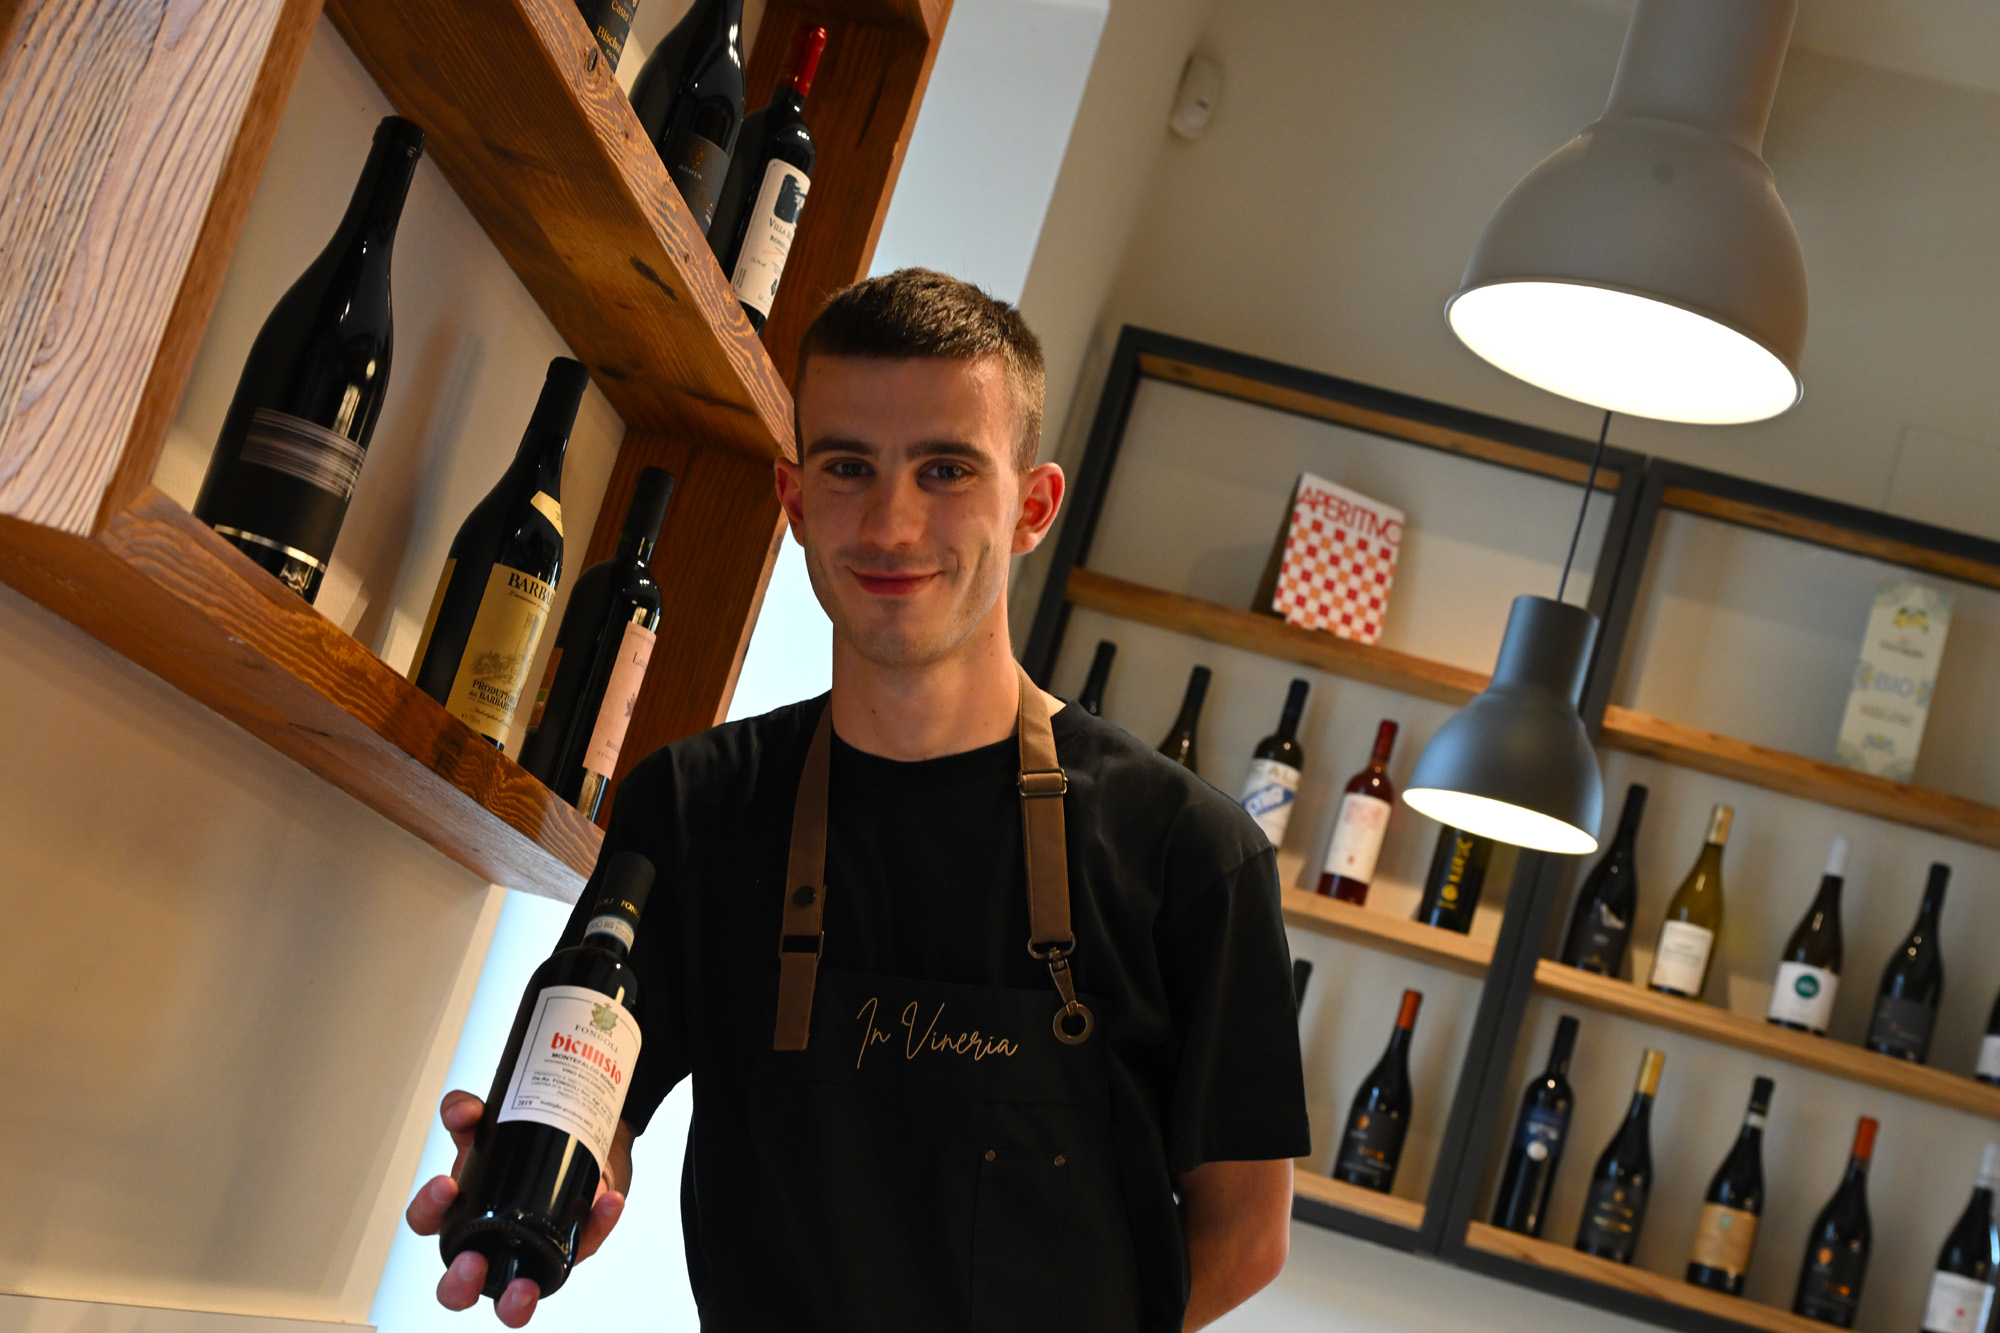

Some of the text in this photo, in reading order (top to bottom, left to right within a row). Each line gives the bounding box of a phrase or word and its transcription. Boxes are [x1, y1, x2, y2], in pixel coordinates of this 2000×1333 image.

[1298, 486, 1404, 546] APERITIVO
[574, 1024, 619, 1053] FONGOLI
[901, 1001, 1018, 1061] Vineria
[551, 1052, 600, 1075] MONTEFALCO
